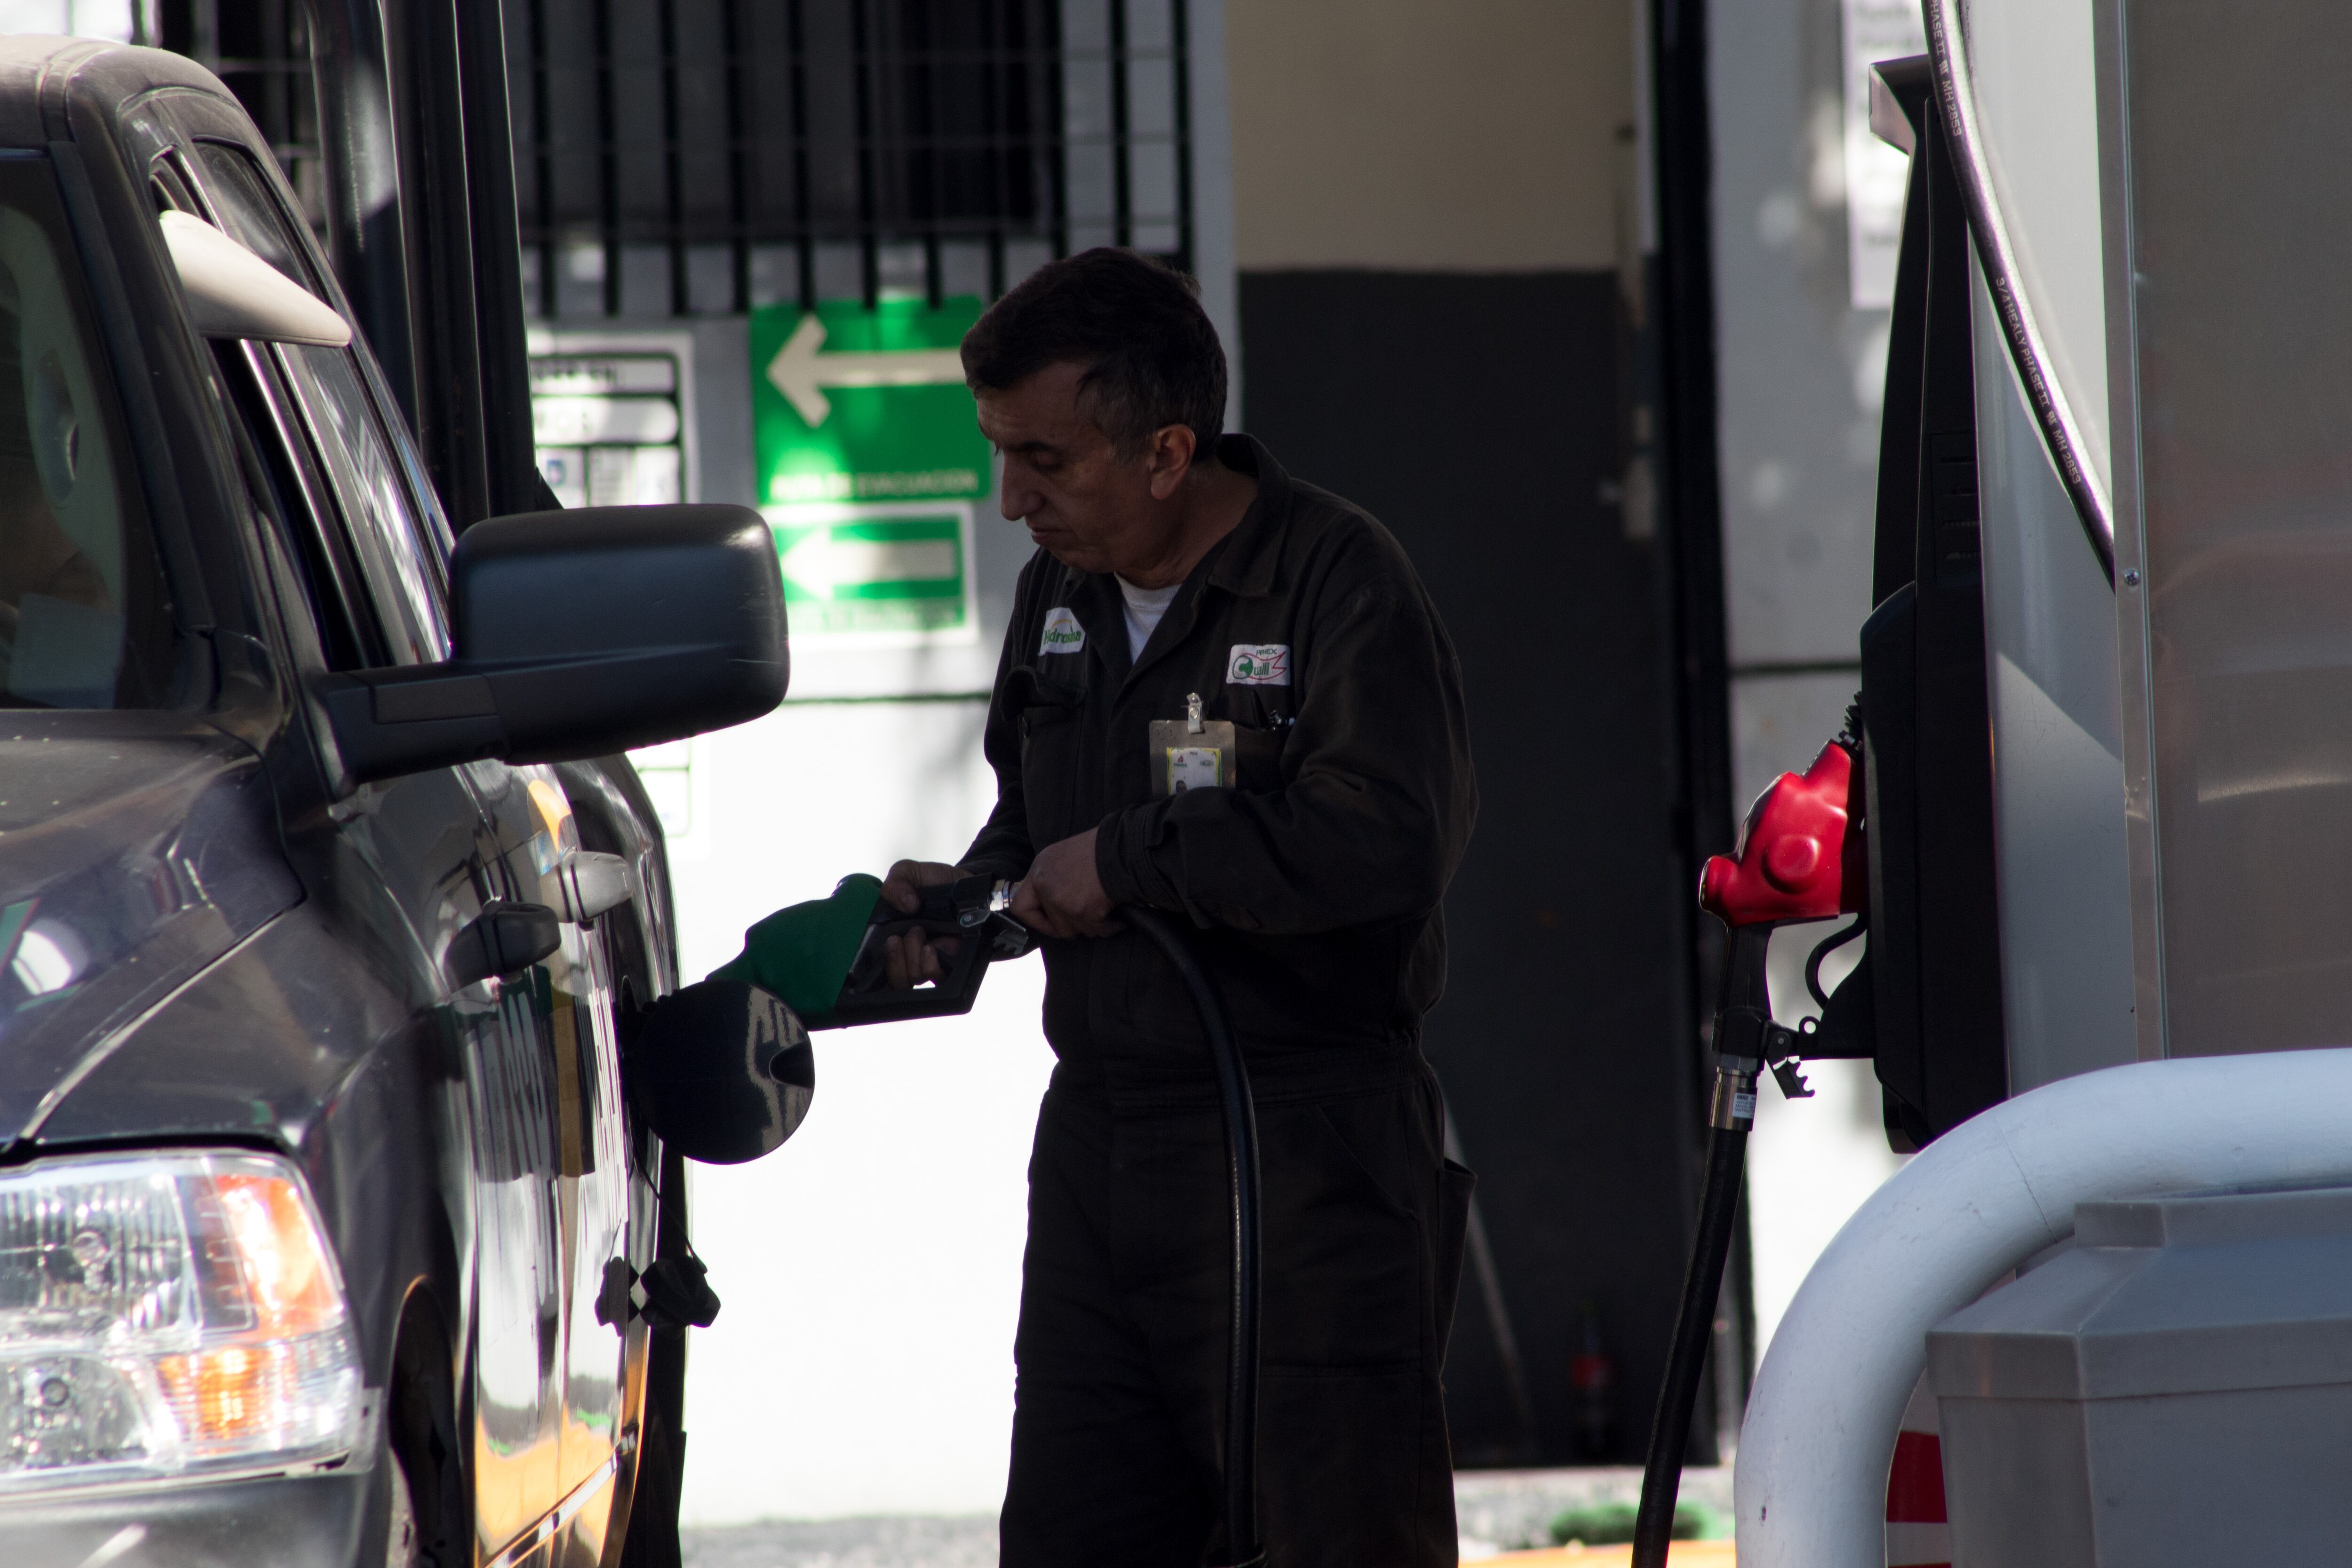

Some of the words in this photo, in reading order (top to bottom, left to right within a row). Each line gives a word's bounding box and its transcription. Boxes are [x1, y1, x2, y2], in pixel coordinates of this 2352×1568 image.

[1942, 80, 1954, 102] MH
[1946, 103, 1963, 136] 2853
[2004, 303, 2027, 346] HEALY
[2021, 348, 2044, 392] PHASE
[2053, 430, 2068, 451] MH
[2062, 452, 2082, 484] 2853
